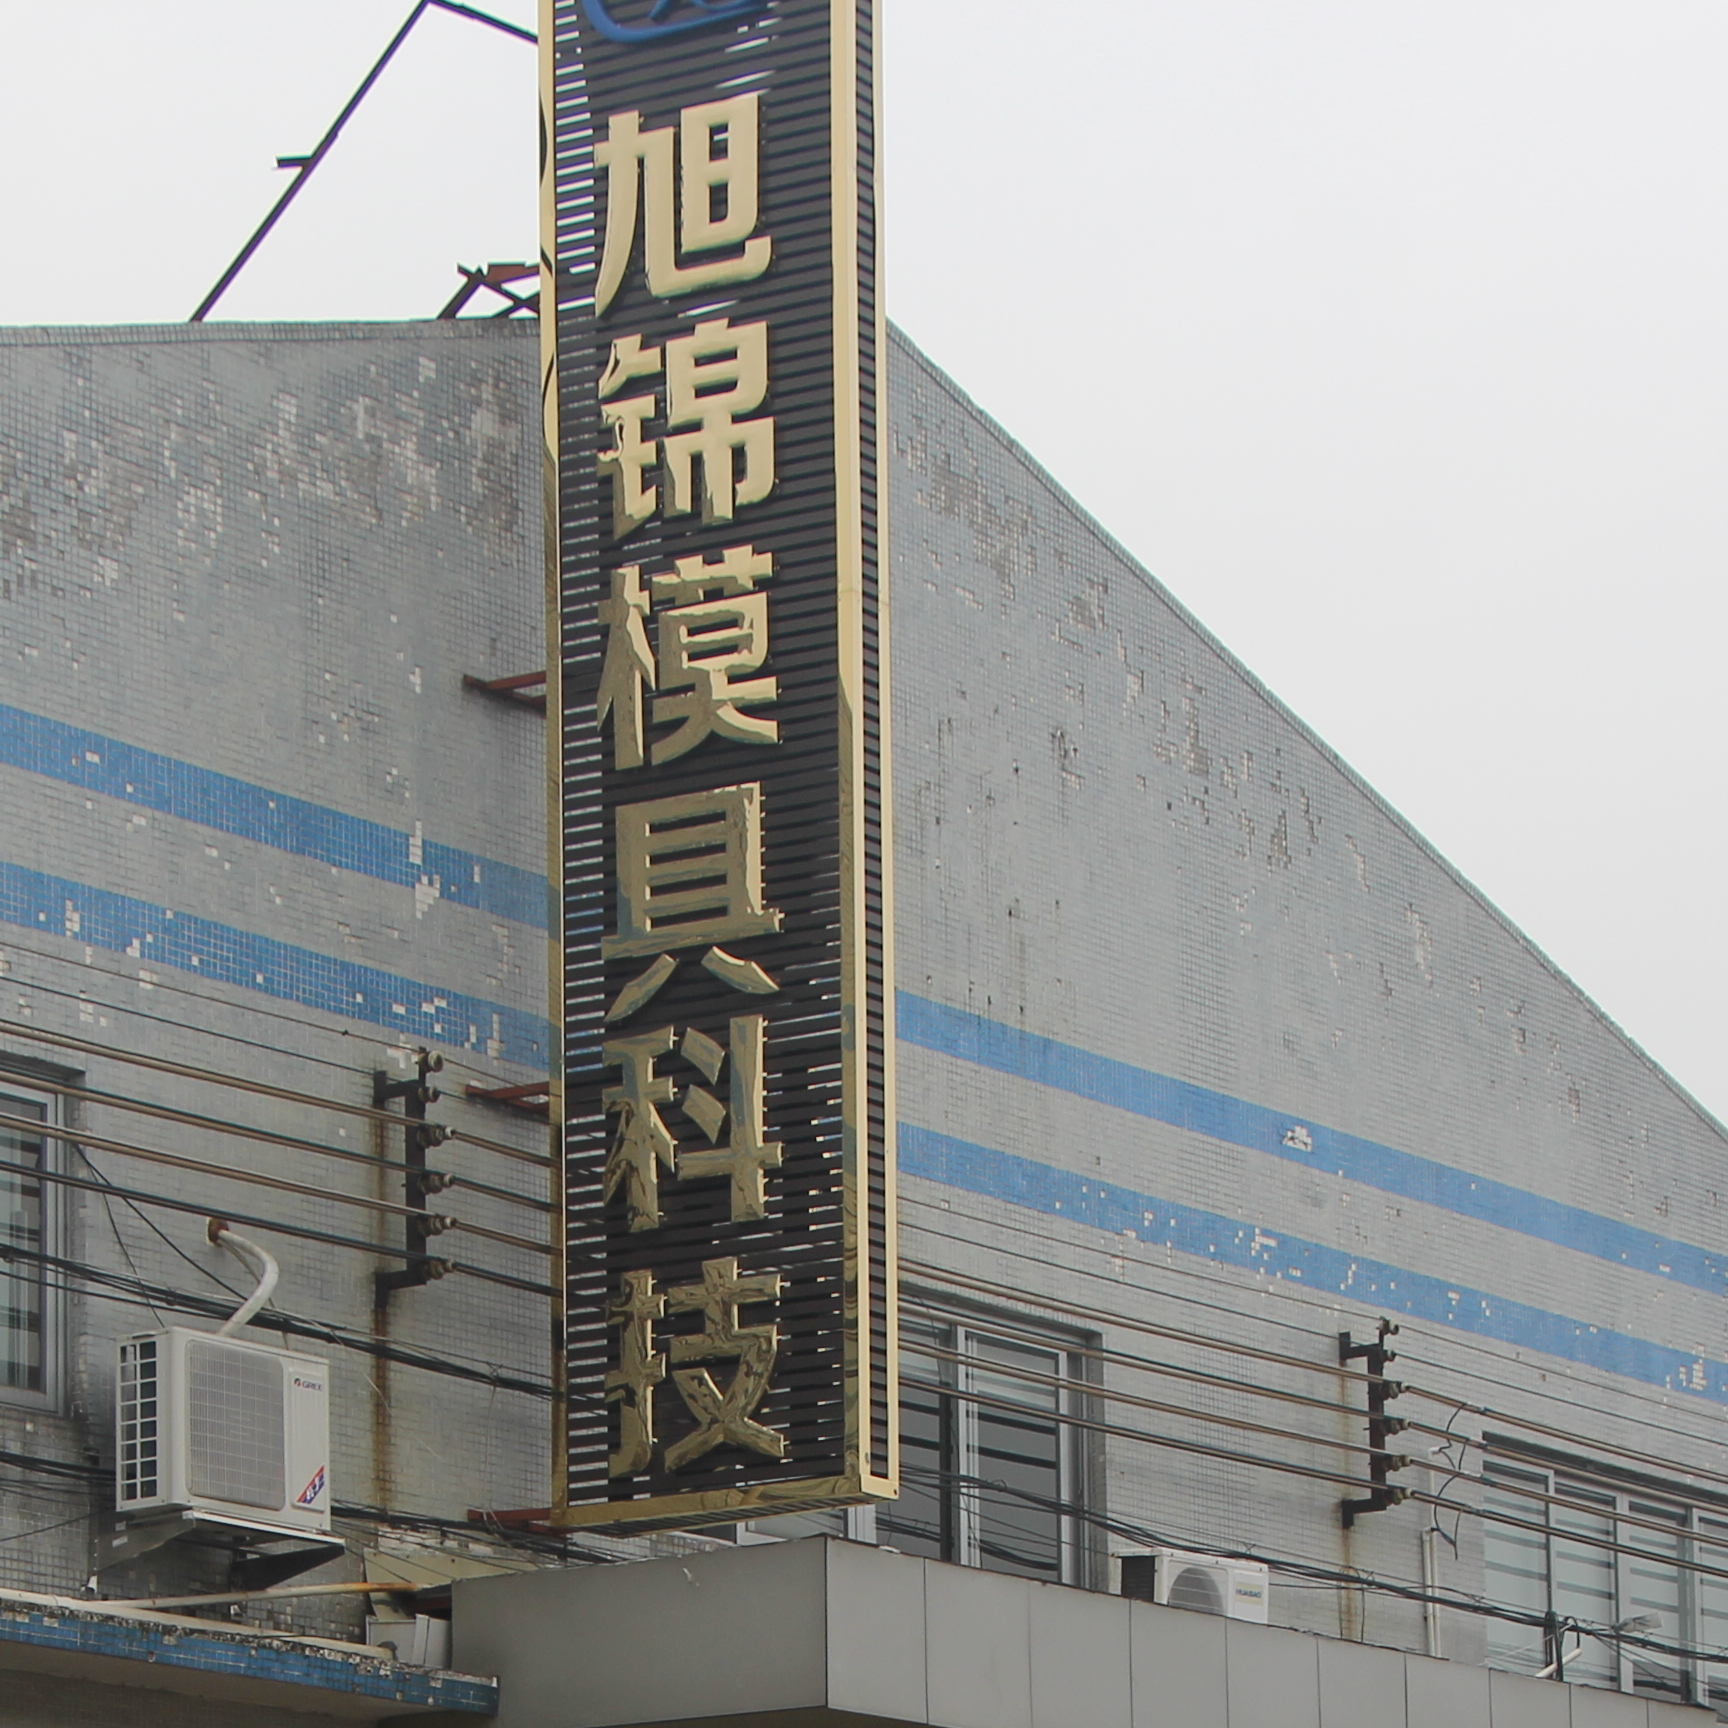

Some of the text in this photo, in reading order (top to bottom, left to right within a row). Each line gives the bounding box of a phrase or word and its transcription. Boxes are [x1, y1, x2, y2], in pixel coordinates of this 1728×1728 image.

[594, 94, 787, 1477] 旭锦模具科技
